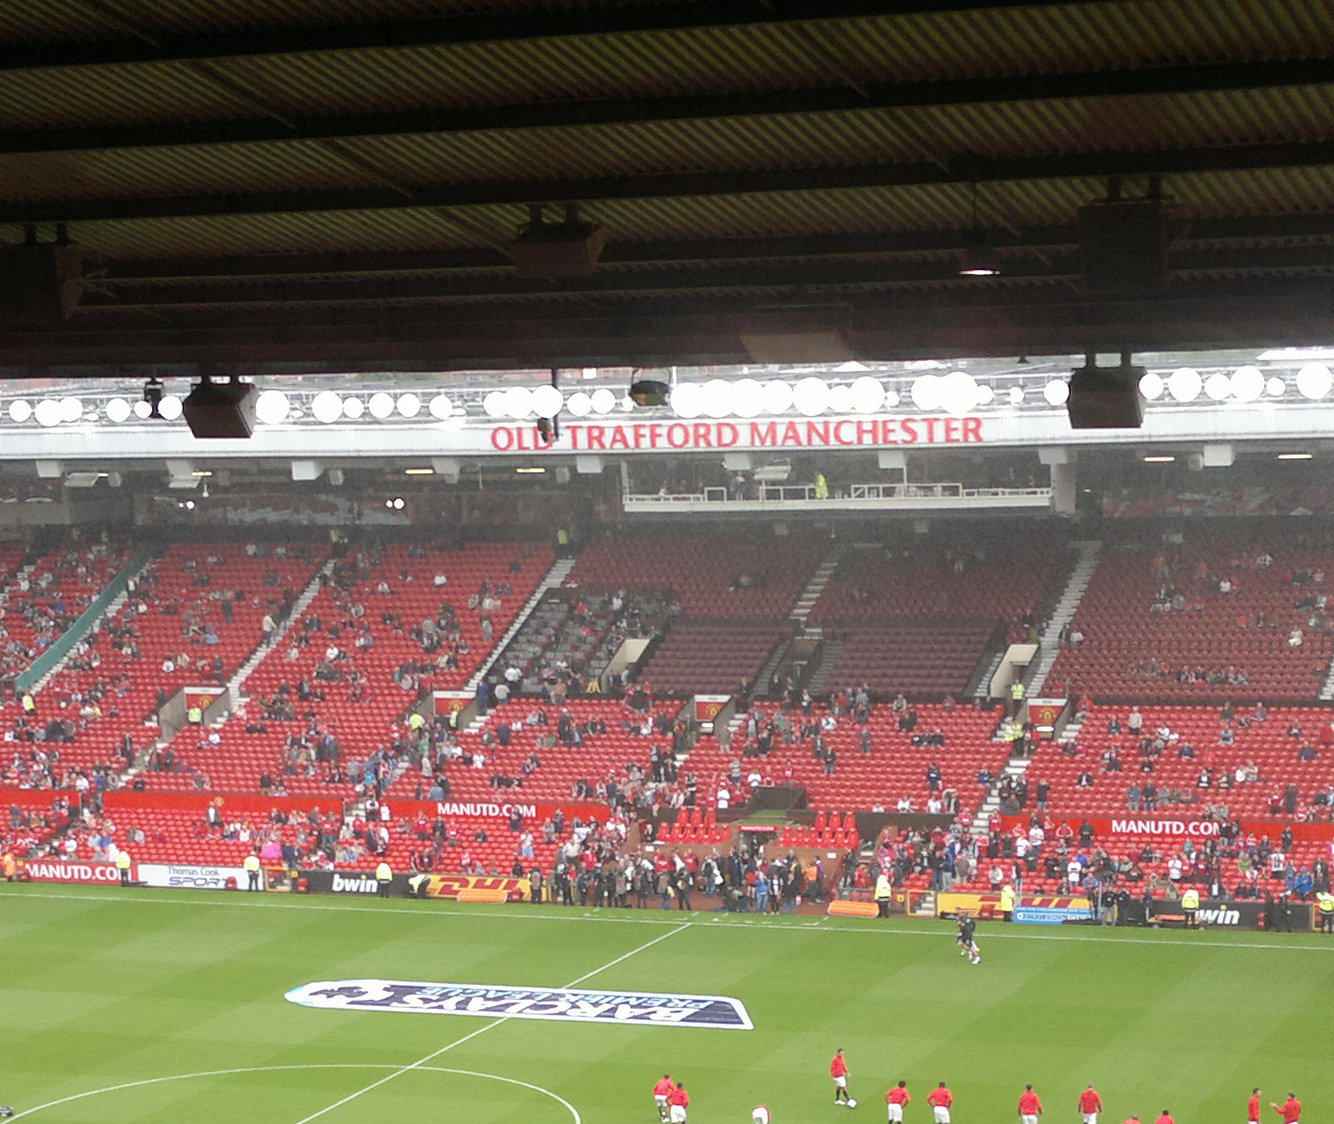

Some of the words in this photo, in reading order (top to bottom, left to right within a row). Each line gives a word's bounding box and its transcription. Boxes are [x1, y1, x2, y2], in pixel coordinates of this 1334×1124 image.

[491, 426, 557, 451] OLD
[567, 421, 739, 449] TRAFFORD
[751, 416, 984, 447] MANCHESTER
[168, 866, 200, 876] Thomas
[201, 868, 220, 877] Cook
[332, 873, 378, 893] bwin
[1195, 903, 1240, 925] win
[391, 994, 701, 1022] BARCLAYS
